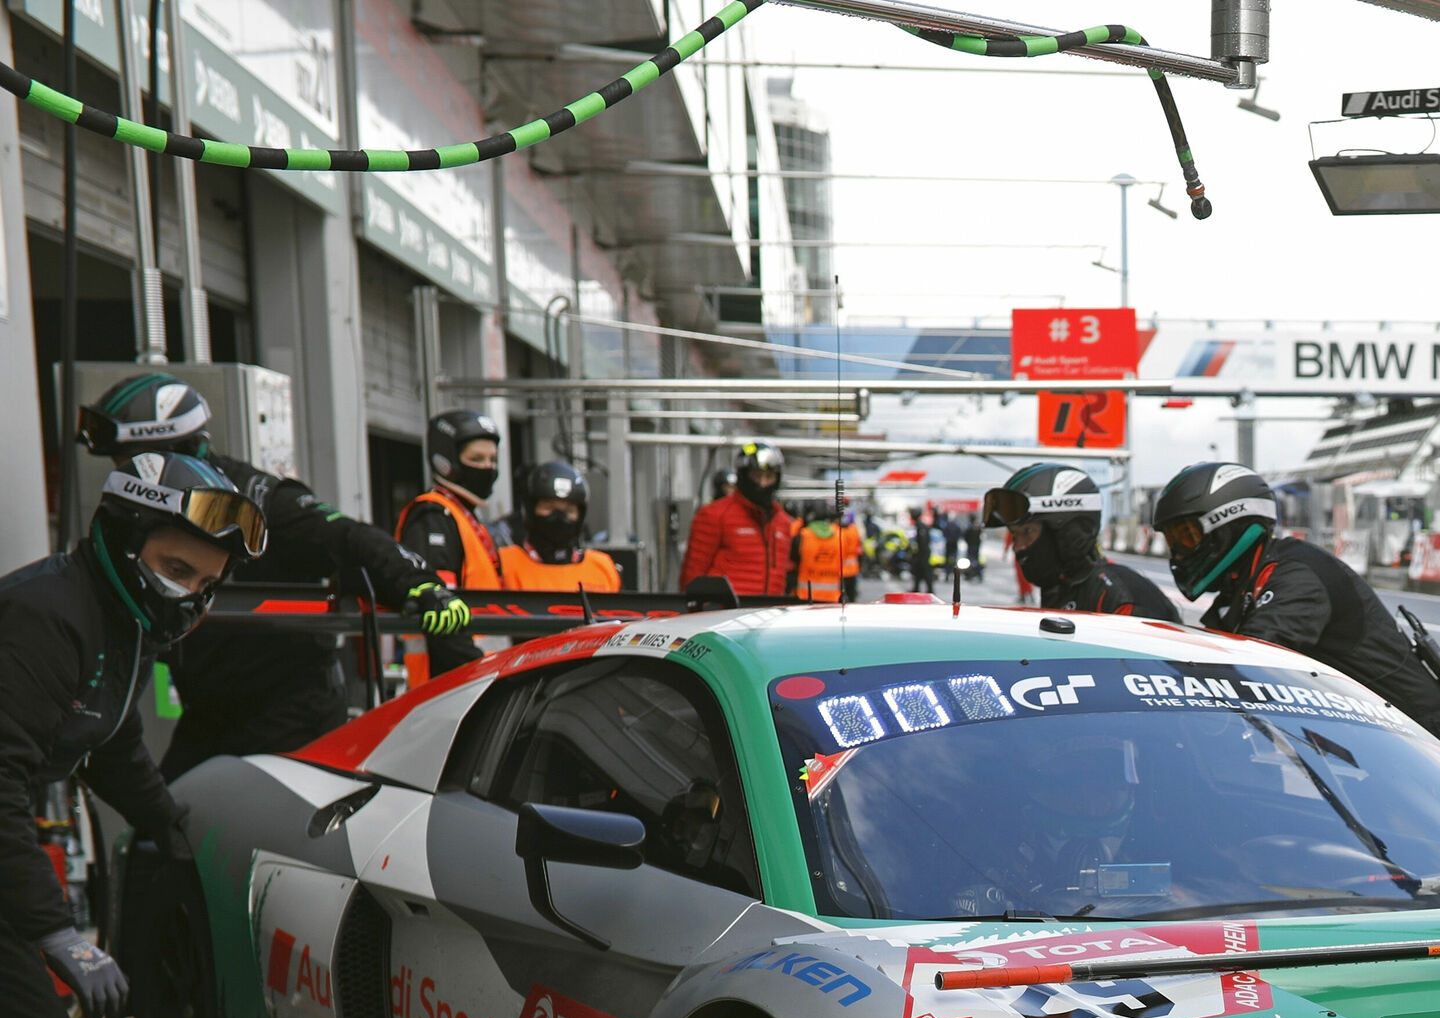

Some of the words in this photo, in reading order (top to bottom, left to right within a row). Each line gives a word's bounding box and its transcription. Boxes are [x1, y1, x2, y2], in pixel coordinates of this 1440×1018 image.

[1371, 90, 1420, 110] Audi
[1080, 315, 1101, 344] 3
[1294, 342, 1414, 379] BMW
[130, 423, 177, 437] uvex
[123, 480, 171, 505] uvex
[1041, 497, 1084, 508] uvex
[1208, 503, 1248, 525] uvex
[640, 633, 671, 648] MIES
[681, 640, 712, 660] RAST
[1123, 674, 1240, 699] GRAN
[1240, 681, 1403, 725] TURISMO
[1140, 698, 1185, 707] THE
[1185, 699, 1240, 709] REAL
[1240, 702, 1319, 715] DRIVING
[1321, 709, 1418, 736] SIMULATOR
[1232, 975, 1260, 1009] ADAC
